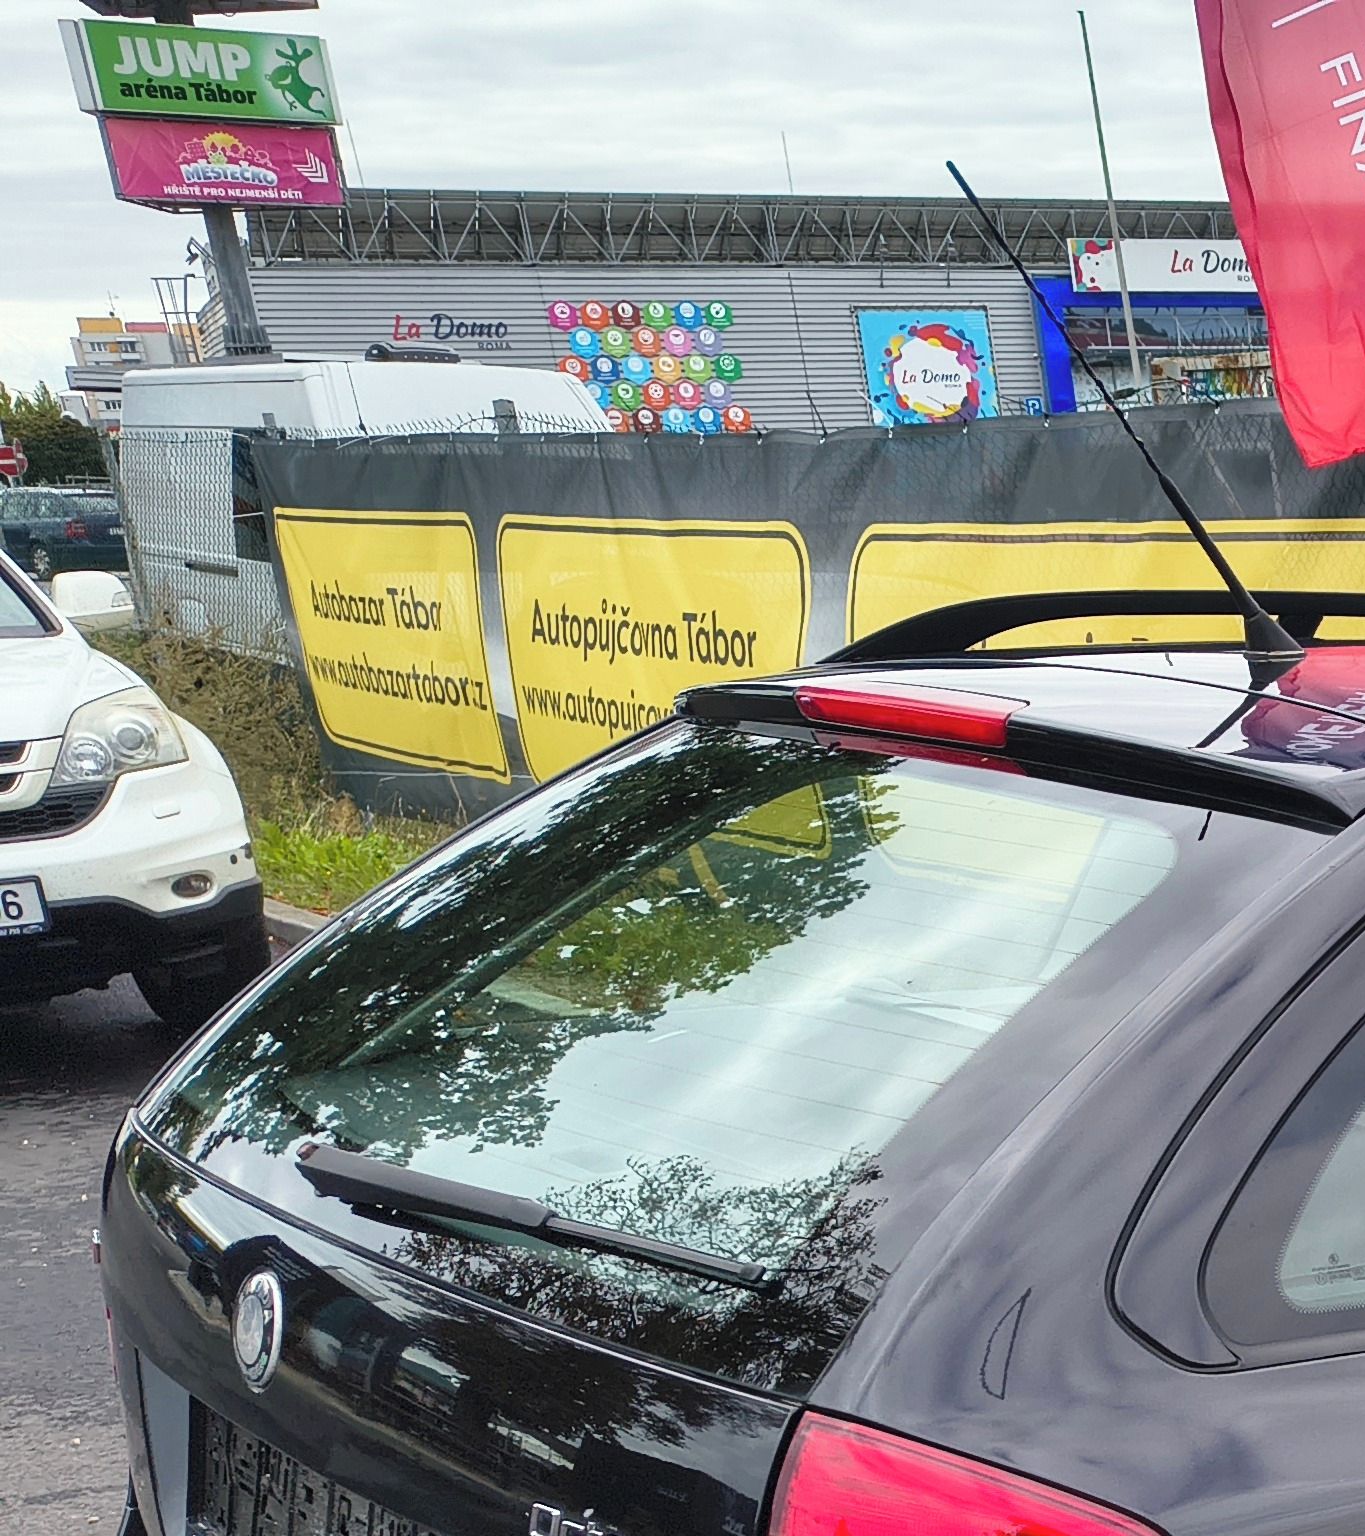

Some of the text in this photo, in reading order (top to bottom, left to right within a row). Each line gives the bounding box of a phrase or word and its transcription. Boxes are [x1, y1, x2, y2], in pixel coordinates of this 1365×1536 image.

[114, 36, 251, 81] JUMP
[120, 79, 257, 105] aréna Tábor
[203, 187, 226, 197] PRO
[1171, 250, 1250, 274] La Dom
[393, 313, 508, 341] La Domo
[902, 368, 961, 384] La Domo
[311, 580, 386, 626] Autobazar
[532, 598, 757, 668] Autopůjčovna Tábor
